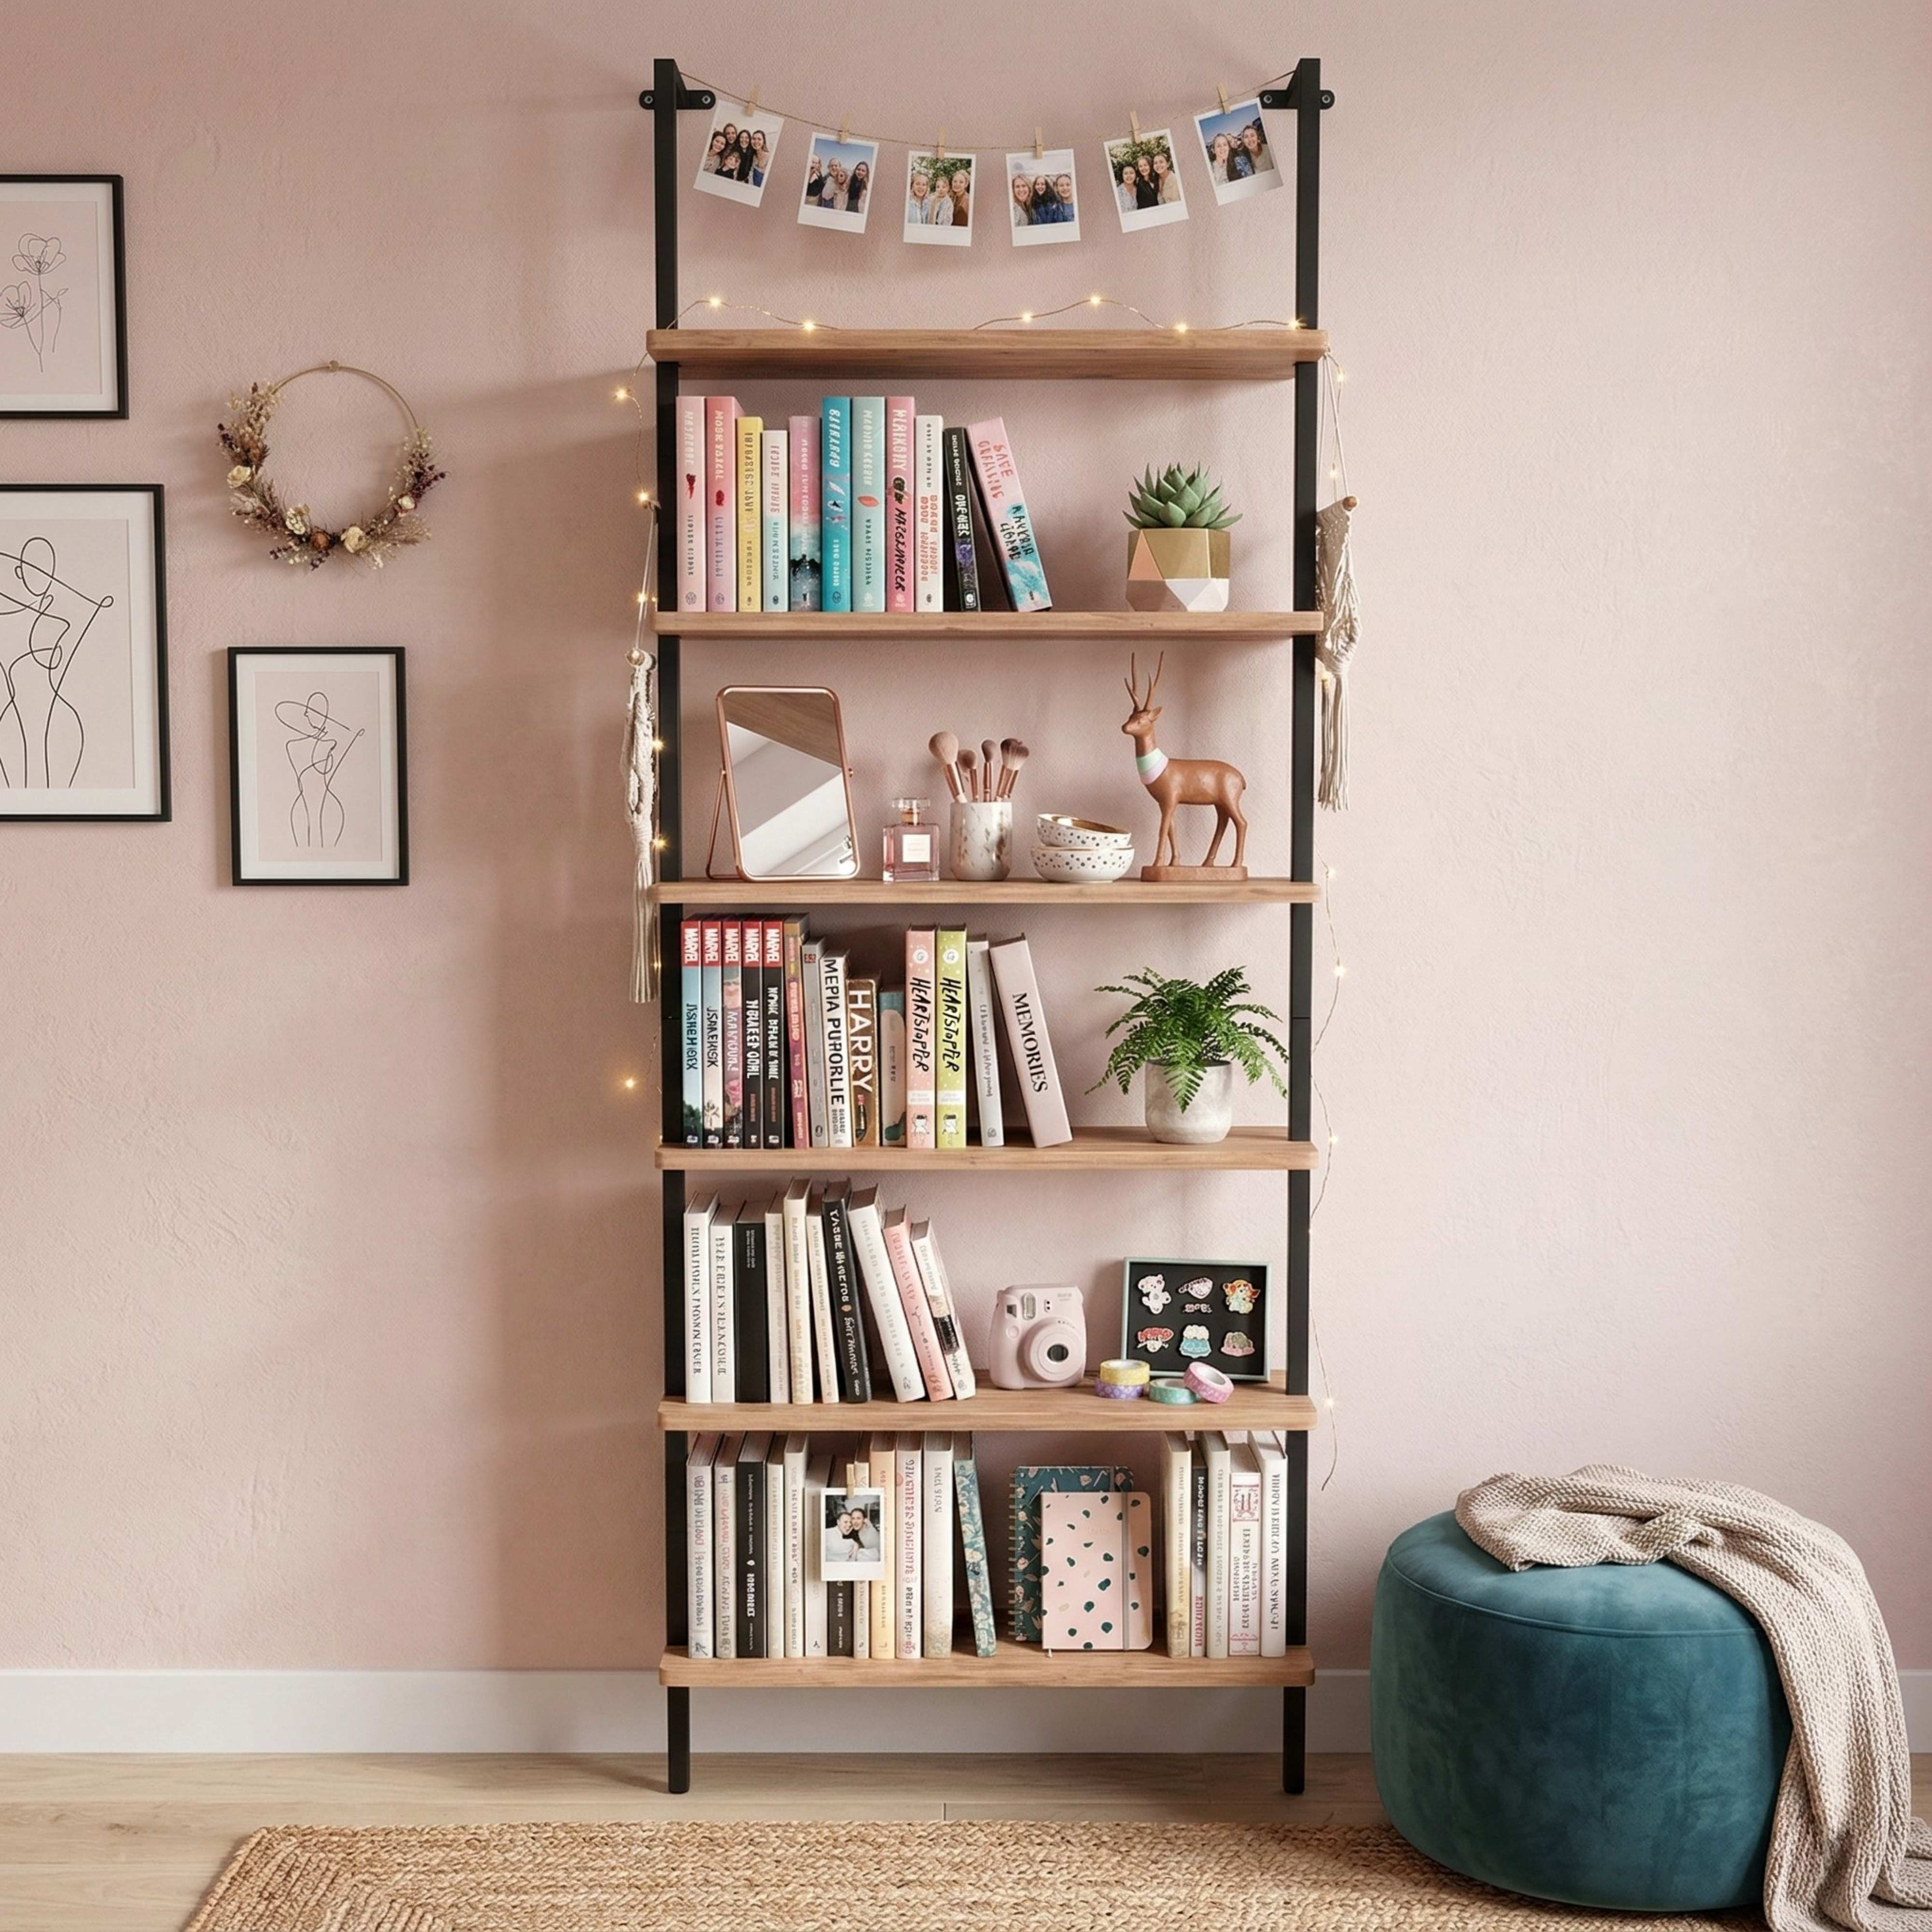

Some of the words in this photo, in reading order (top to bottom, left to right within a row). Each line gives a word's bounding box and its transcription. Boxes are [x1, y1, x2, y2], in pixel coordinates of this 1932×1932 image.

[684, 928, 698, 964] MARVEL
[704, 928, 718, 964] MARVEL
[724, 928, 739, 964] MARVEL
[745, 928, 759, 964] MARVEL
[766, 928, 780, 964] MARVEL
[848, 989, 873, 1093] HARRY
[1012, 992, 1049, 1093] MEMORIES
